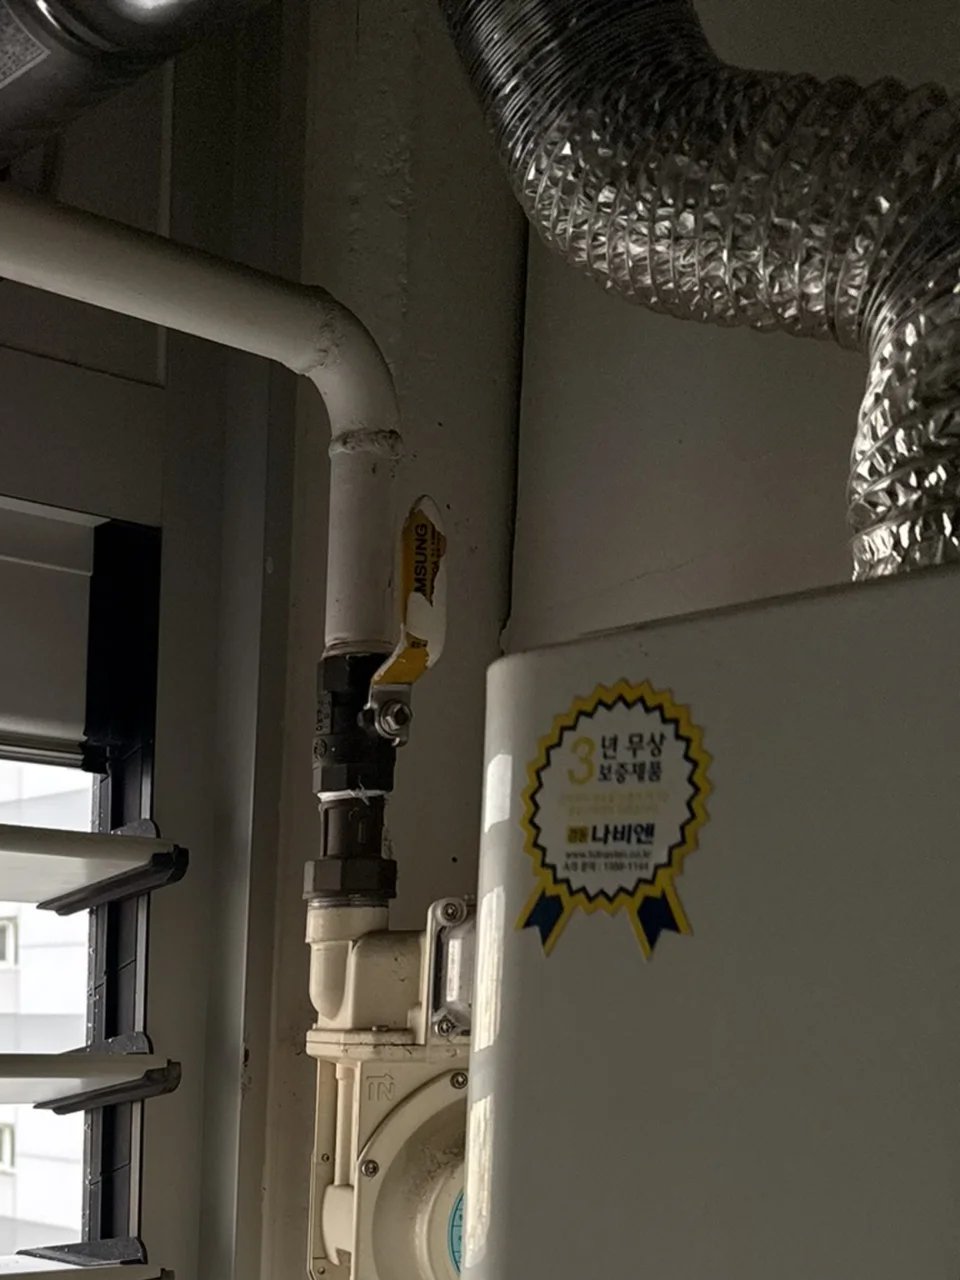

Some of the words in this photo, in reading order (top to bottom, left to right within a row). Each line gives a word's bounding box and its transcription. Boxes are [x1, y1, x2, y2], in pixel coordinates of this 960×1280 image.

[567, 736, 596, 785] 3
[625, 731, 667, 758] 무상
[367, 1081, 395, 1102] IN
